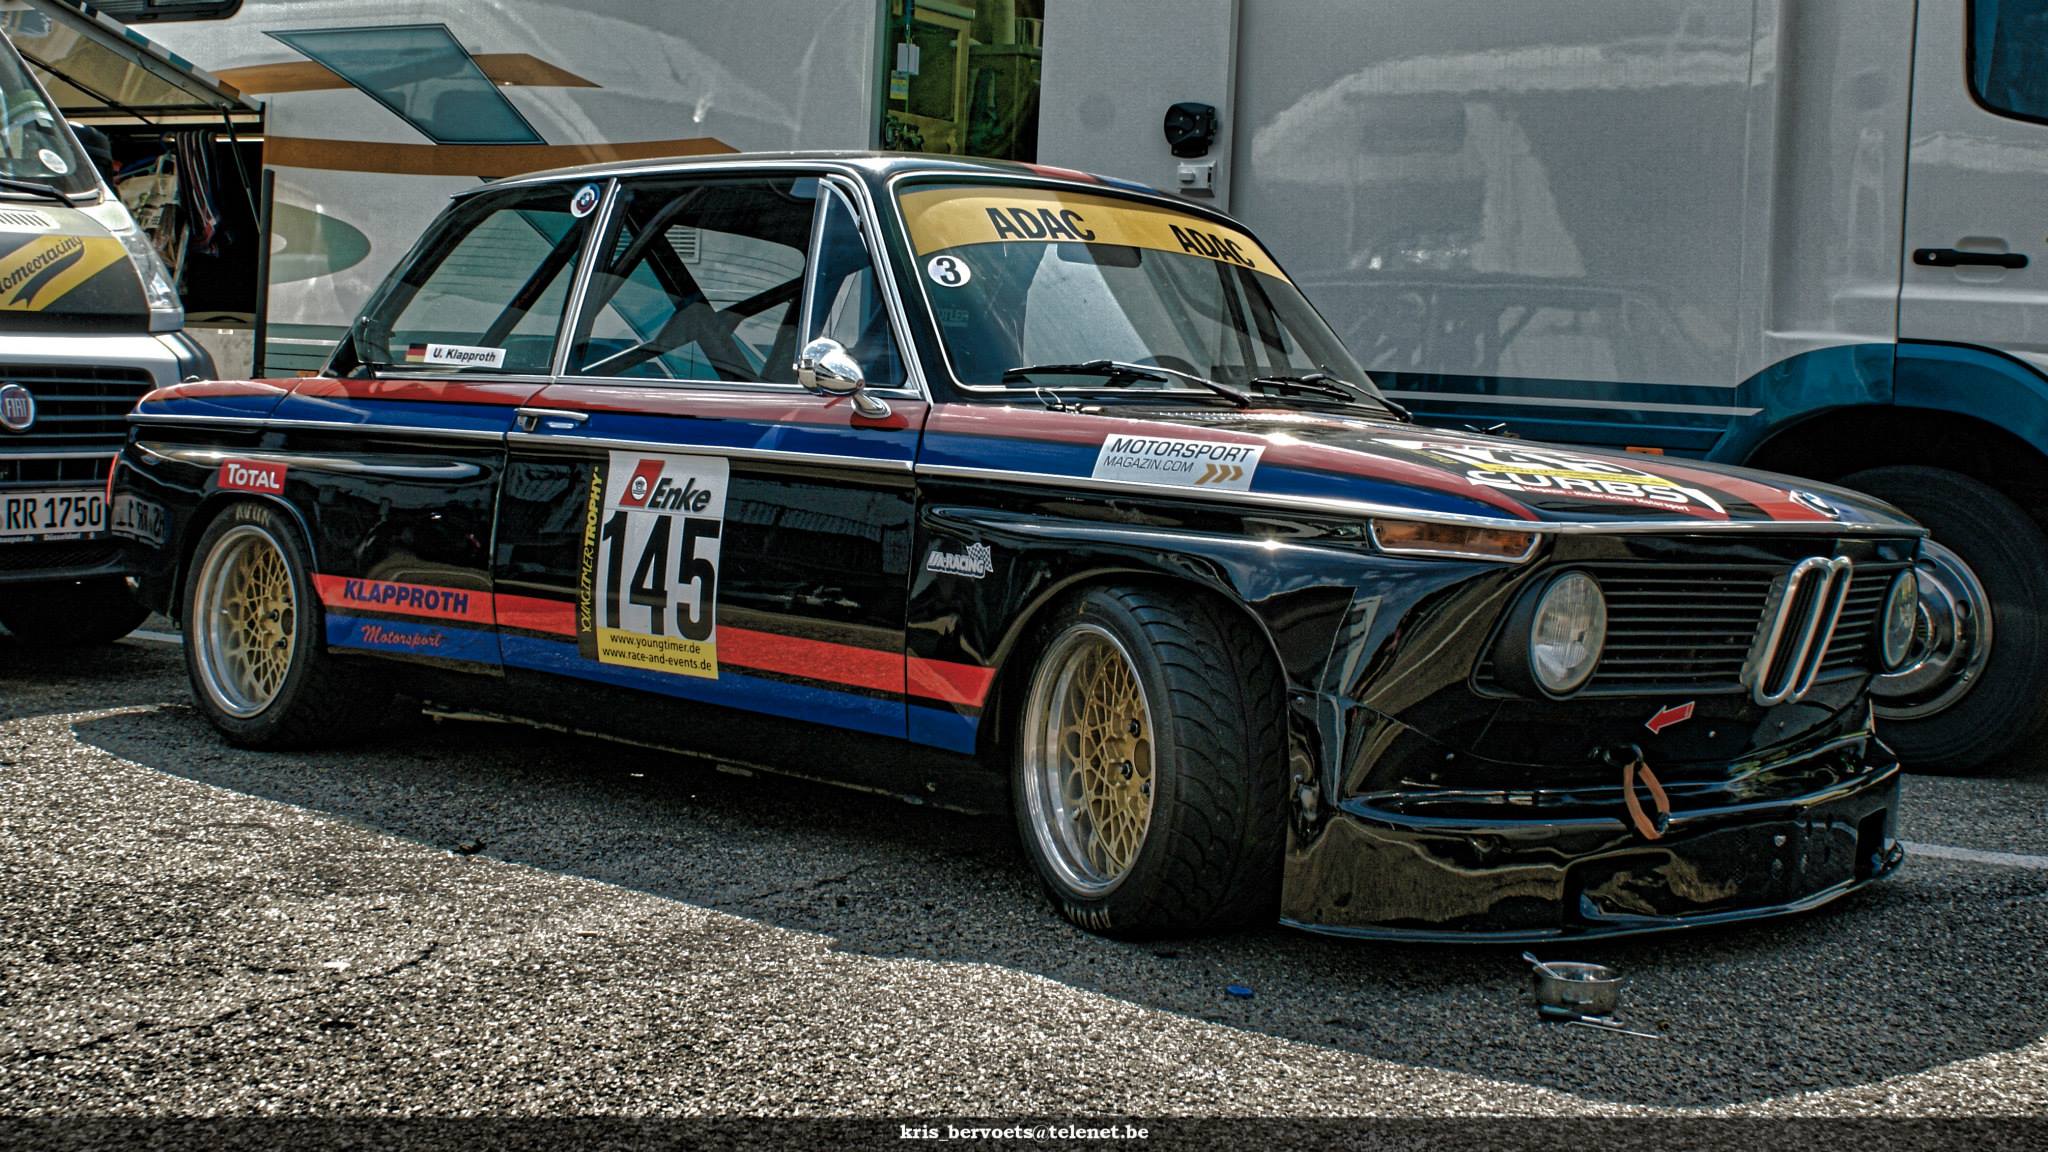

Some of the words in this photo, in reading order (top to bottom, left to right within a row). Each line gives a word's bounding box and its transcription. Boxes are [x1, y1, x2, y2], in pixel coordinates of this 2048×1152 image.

[985, 207, 1096, 241] ADAC
[1168, 224, 1255, 268] ADAC
[0, 235, 83, 294] omeoracing
[936, 258, 962, 285] 3
[433, 347, 443, 359] U.
[446, 348, 496, 362] Klapproth
[1103, 455, 1194, 473] MAGAZIN.COM
[1111, 438, 1255, 463] MOTORSPORT
[228, 463, 280, 489] TOTAL
[1467, 470, 1689, 504] CURBS
[648, 477, 712, 513] Enke
[6, 498, 37, 529] RR
[44, 496, 101, 528] 1750
[602, 510, 722, 642] 145
[344, 579, 470, 615] KLAPPROTH
[361, 624, 446, 648] Motorsport
[610, 632, 701, 655] www.youngtimer.de
[602, 646, 712, 672] www.race-and-events.de
